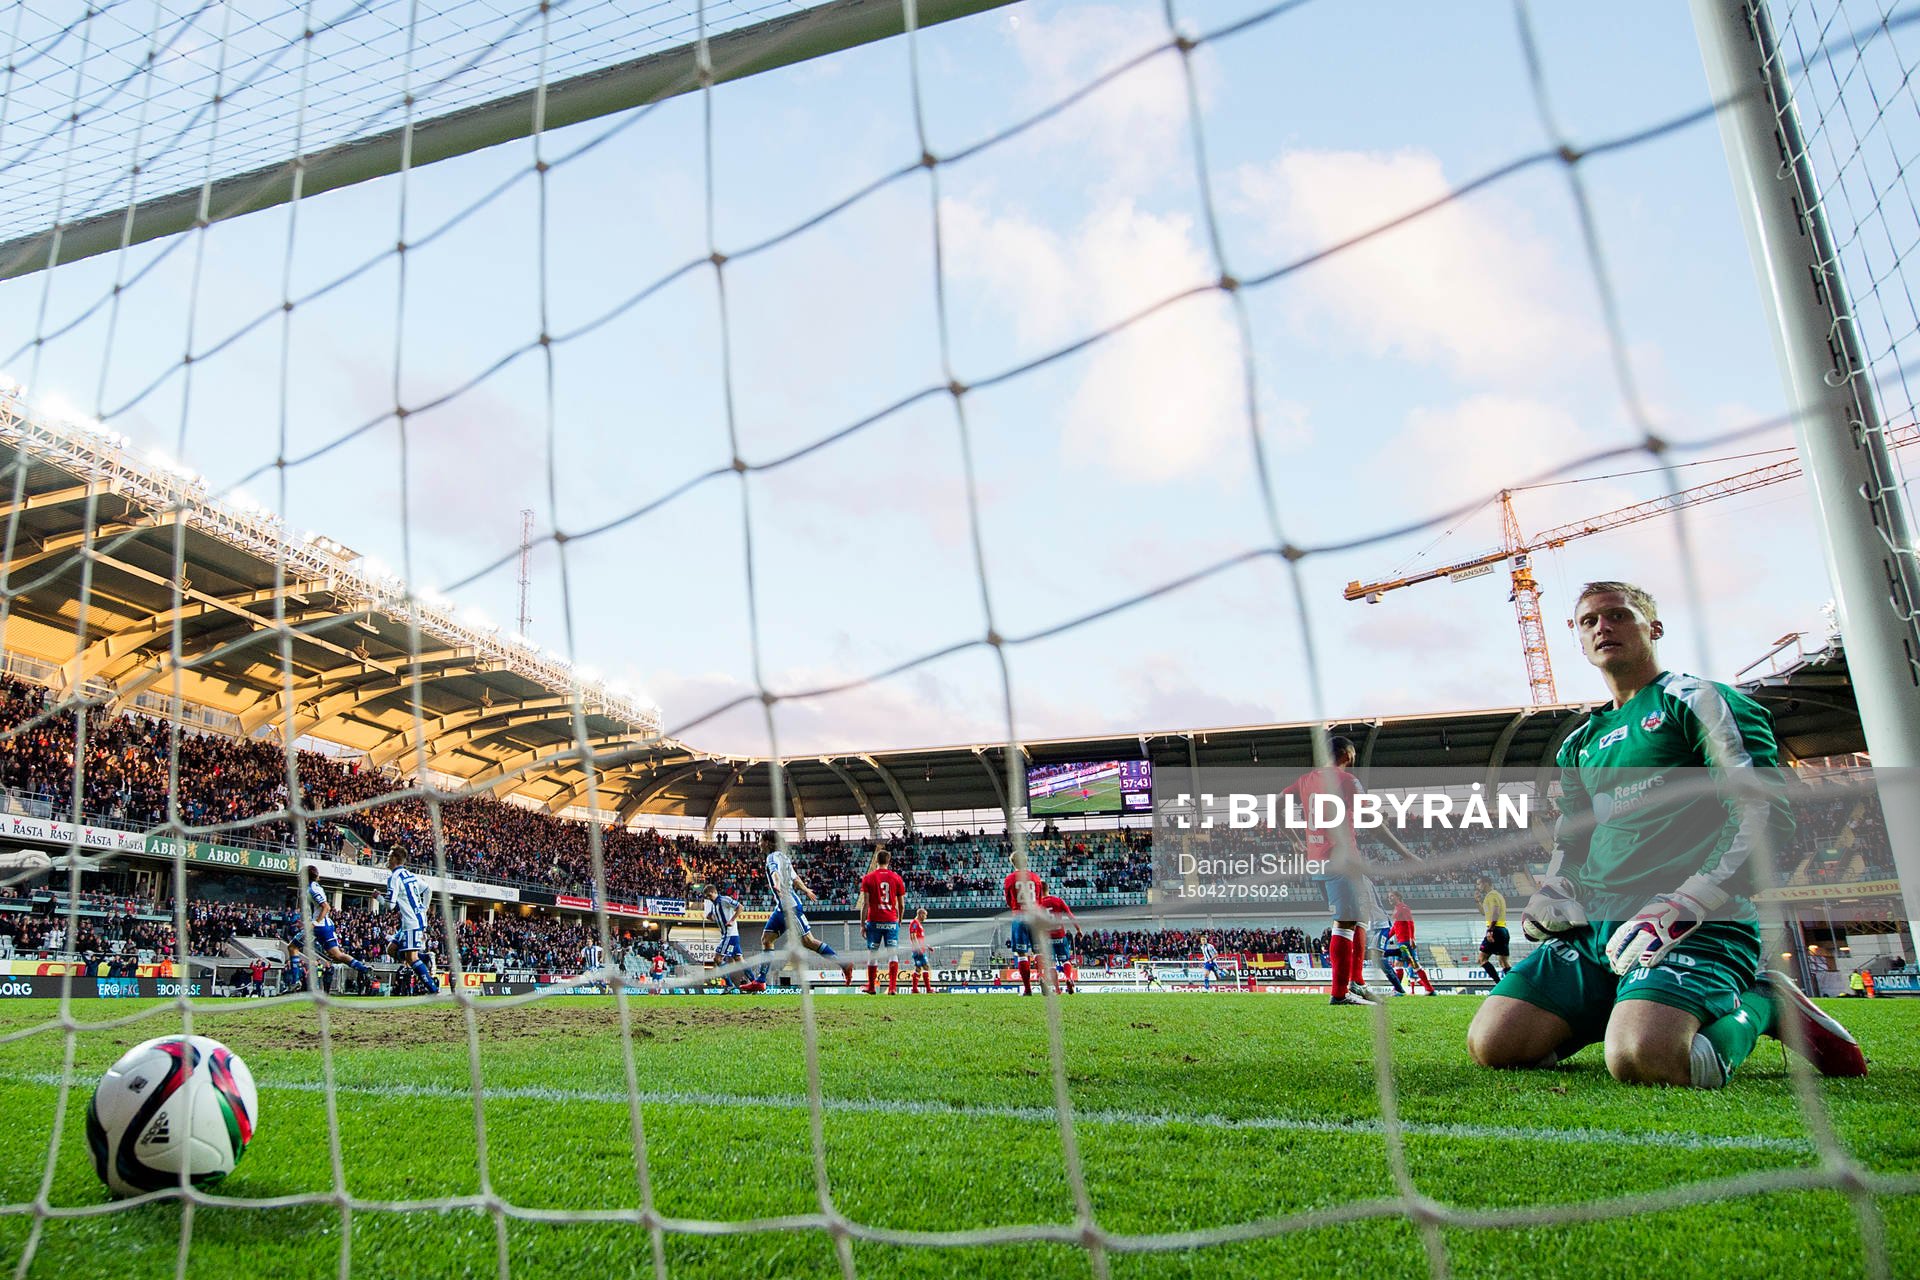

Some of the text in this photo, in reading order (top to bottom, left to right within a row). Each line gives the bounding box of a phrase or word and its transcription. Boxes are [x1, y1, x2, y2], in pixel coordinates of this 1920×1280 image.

[1453, 566, 1490, 580] SKANSKA
[1122, 768, 1128, 776] 2
[1123, 779, 1148, 788] 57:43
[1614, 775, 1665, 800] Resurs
[13, 824, 43, 837] RASTA
[85, 834, 112, 846] RASTA
[118, 838, 144, 850] RASTA
[150, 840, 288, 870] ÅBRO ÅBRO ÅBRO
[880, 882, 890, 903] 3
[938, 970, 993, 980] GITAB
[1080, 971, 1136, 979] KUMHO TYRES
